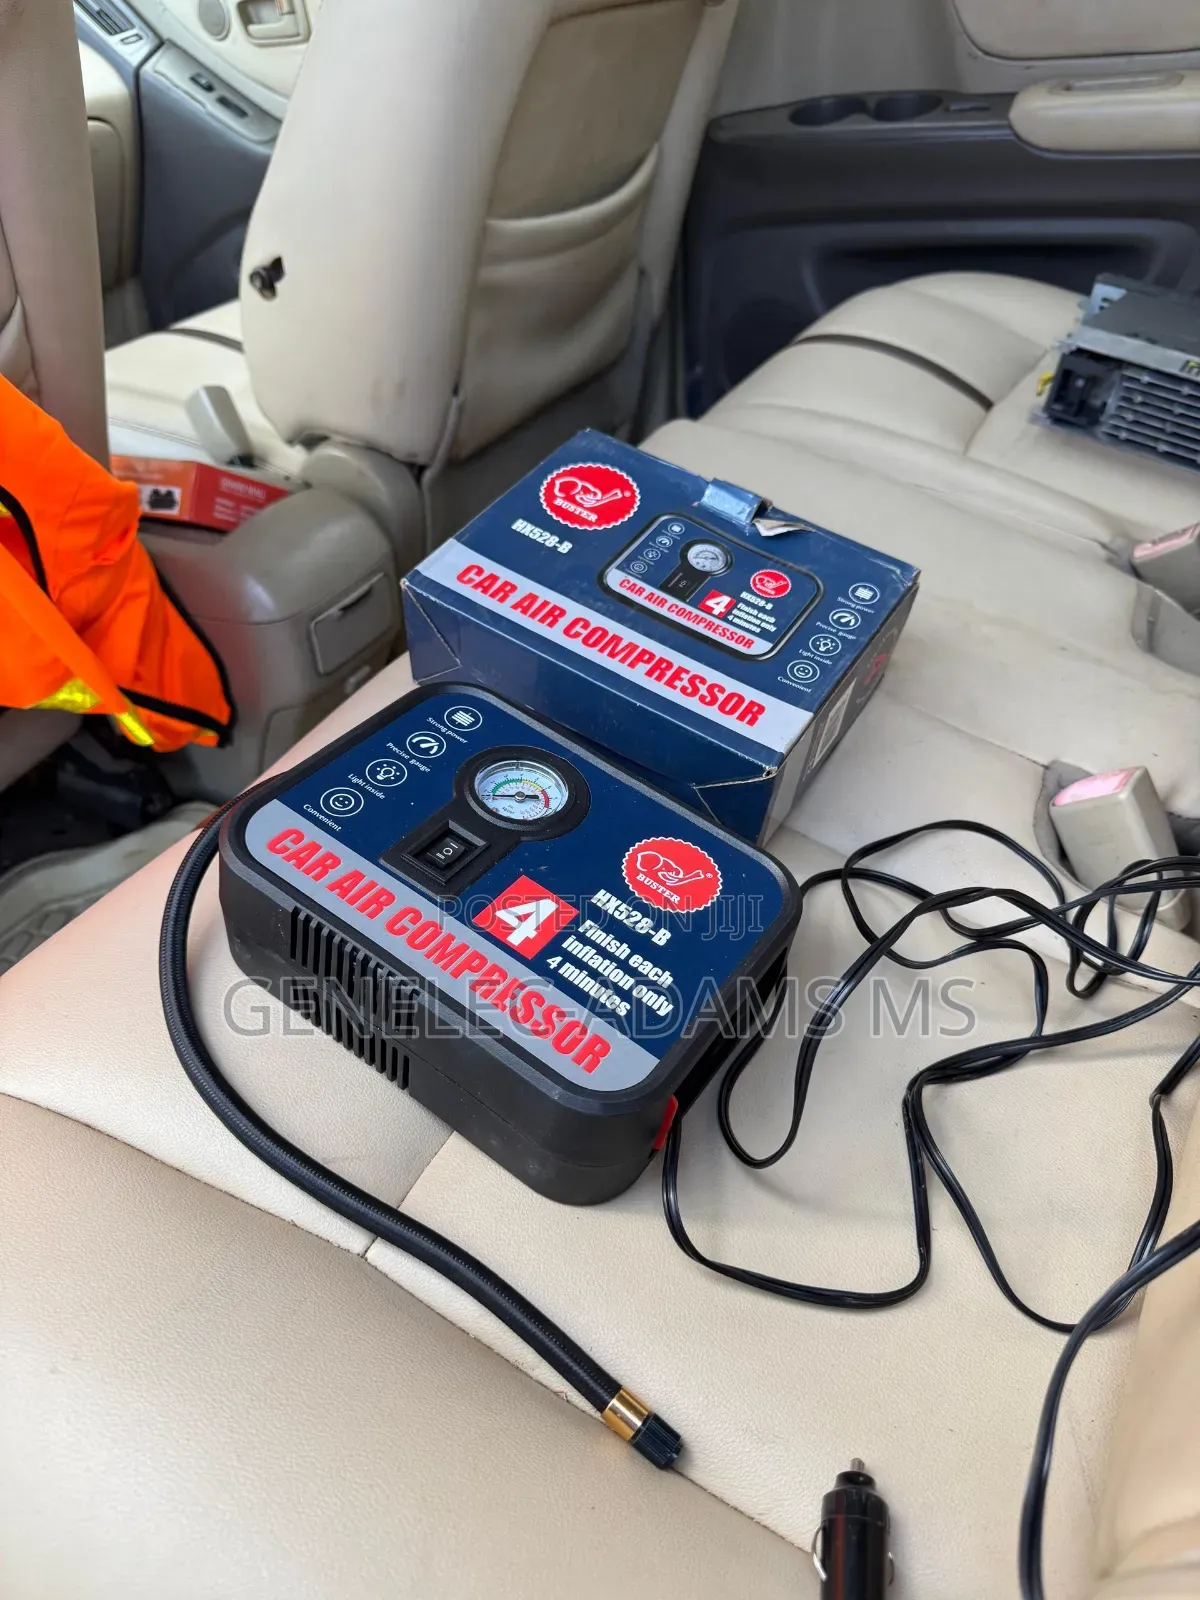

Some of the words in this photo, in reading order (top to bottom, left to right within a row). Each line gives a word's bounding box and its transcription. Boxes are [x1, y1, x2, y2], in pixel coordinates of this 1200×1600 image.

[553, 497, 598, 523] BUSTER
[511, 518, 573, 555] HX528-B
[619, 578, 646, 597] CAR
[644, 592, 668, 609] AIR
[667, 603, 756, 650] COMPRESSOR
[705, 595, 732, 616] 4
[737, 602, 759, 616] Finish
[758, 612, 777, 624] each
[836, 596, 857, 609] Strong
[855, 605, 875, 614] power
[732, 617, 762, 634] minutes
[760, 621, 778, 633] only
[816, 621, 837, 633] Precise
[456, 563, 518, 605] CAR
[510, 591, 567, 629] AIR
[562, 616, 767, 728] COMPRESSOR
[798, 648, 815, 659] Light
[814, 656, 833, 665] inside
[777, 676, 813, 694] Convenient
[426, 716, 448, 733] Strong
[446, 730, 468, 745] power
[386, 742, 410, 760] Precise
[409, 755, 431, 773] gauge
[348, 773, 366, 788] Light
[364, 783, 386, 800] inside
[303, 803, 343, 833] Convenient
[635, 871, 682, 906] BUSTER
[495, 897, 559, 947] 4
[590, 888, 672, 947] HX528-B
[265, 827, 342, 883] CAR
[325, 868, 398, 921] AIR
[383, 905, 612, 1075] COMPRESSOR
[577, 918, 632, 960] Finish
[628, 951, 674, 990] each
[546, 955, 559, 970] 4
[557, 959, 632, 1017] minutes
[561, 934, 641, 994] inflation
[635, 980, 675, 1018] only
